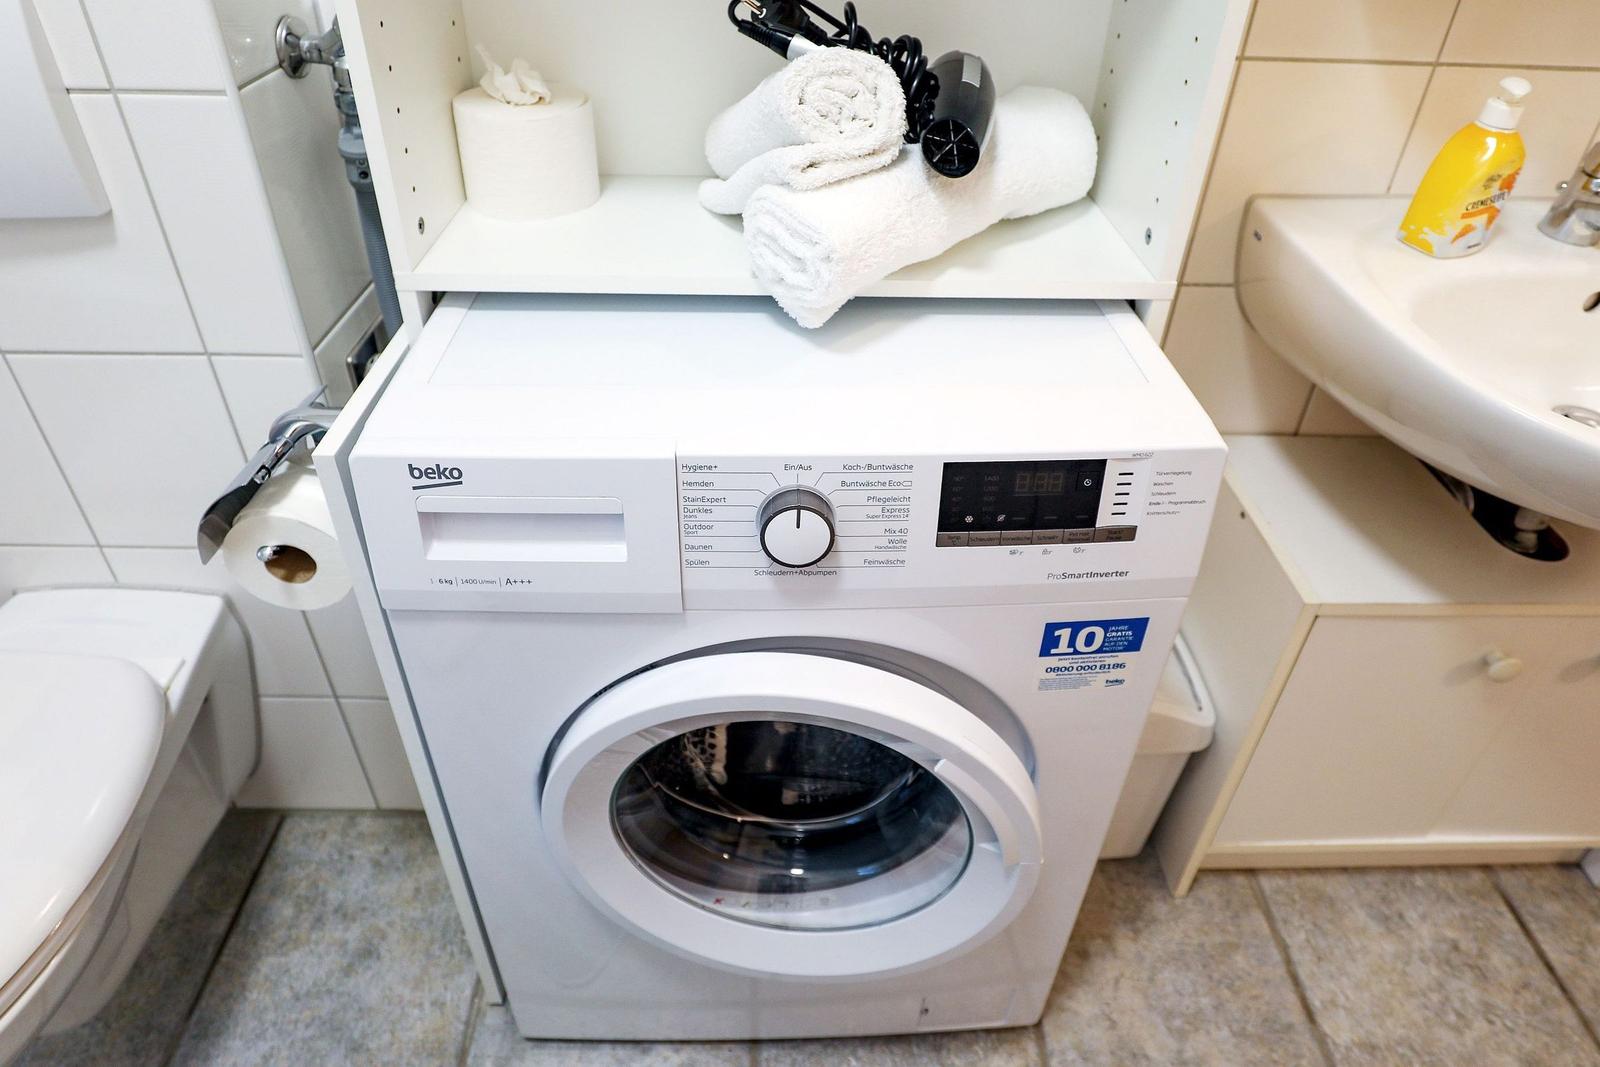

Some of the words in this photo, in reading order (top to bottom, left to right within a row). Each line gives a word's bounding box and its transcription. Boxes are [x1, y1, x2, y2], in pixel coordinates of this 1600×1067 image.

[681, 463, 718, 472] Hygiene+
[784, 463, 813, 471] Ein/Aus
[842, 463, 914, 471] Koch-/Buntwäsche
[407, 463, 463, 480] beko
[840, 480, 887, 488] Buntwäsche
[683, 496, 727, 504] StainExpert
[867, 495, 911, 504] Pflegeleicht
[897, 527, 909, 535] 40
[1047, 570, 1130, 580] ProSmartInverter
[445, 578, 453, 586] kg
[505, 578, 533, 586] A+++
[1050, 626, 1105, 654] 10
[1045, 665, 1074, 674] 0800
[1076, 664, 1097, 672] 000
[1099, 662, 1126, 671] 8186
